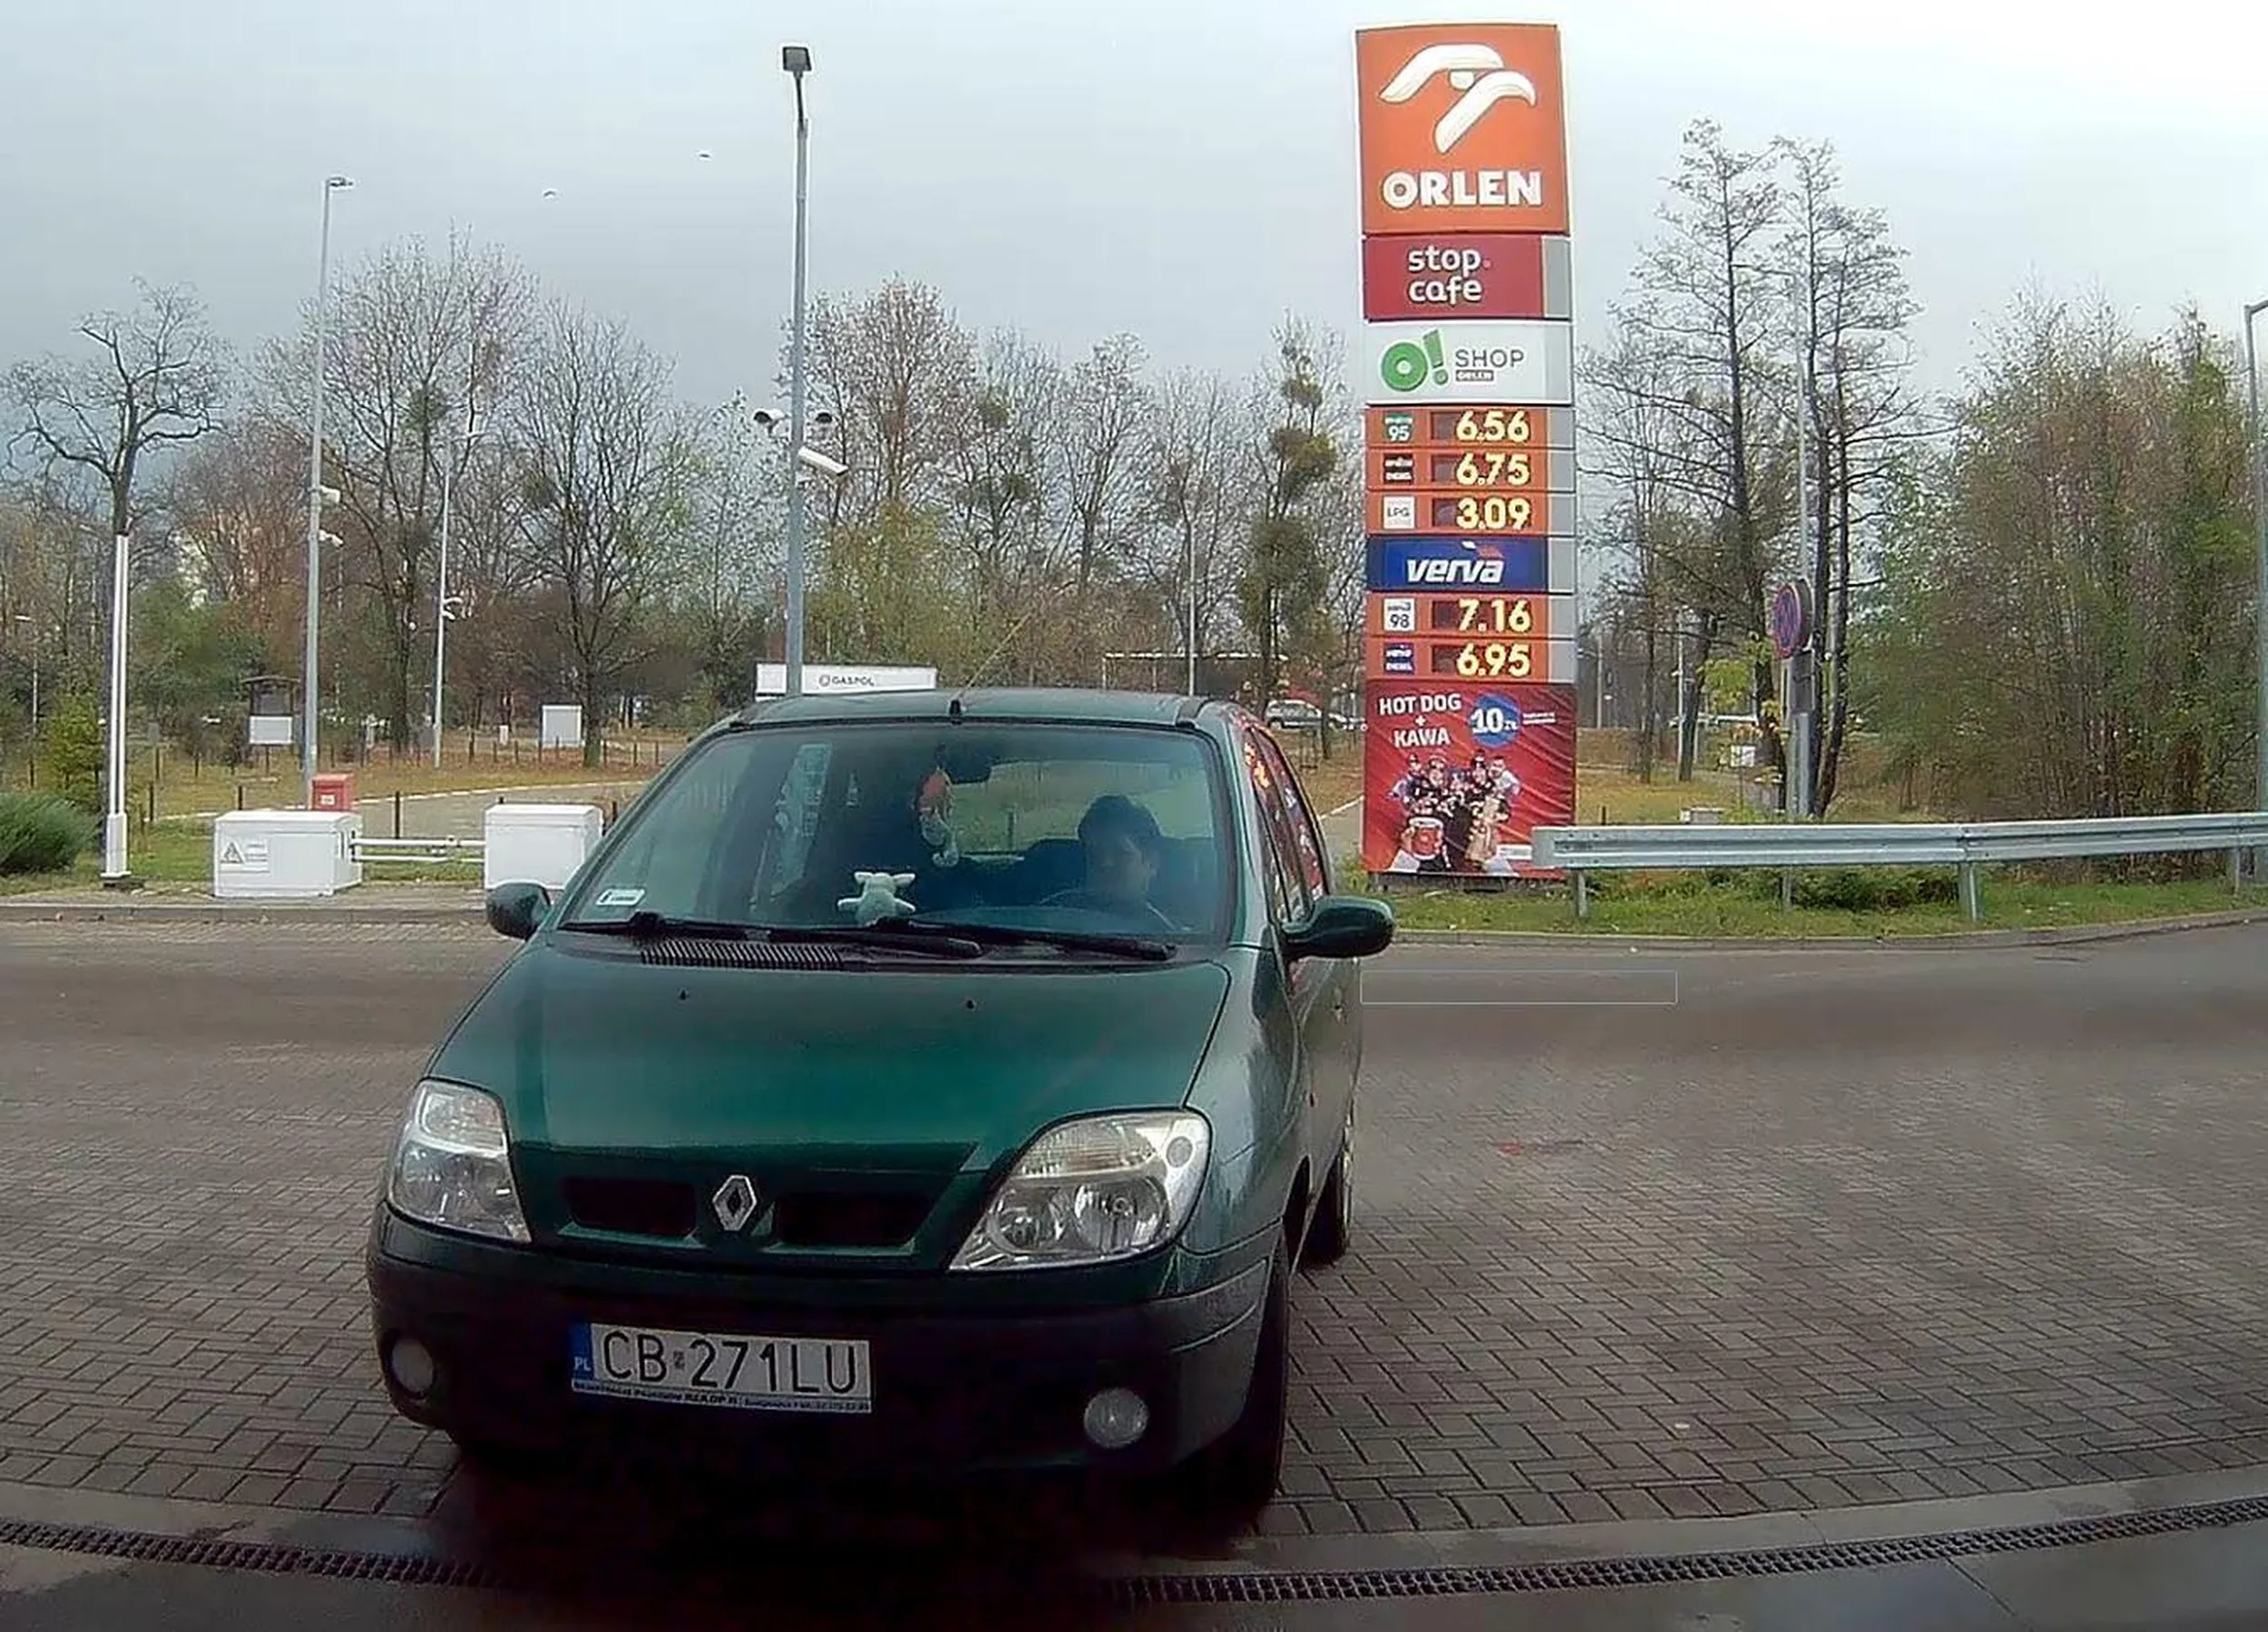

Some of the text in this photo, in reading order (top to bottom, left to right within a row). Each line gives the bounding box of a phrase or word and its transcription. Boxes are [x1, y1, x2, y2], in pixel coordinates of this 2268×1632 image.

[1382, 171, 1542, 209] ORLEN
[1408, 246, 1481, 277] stop
[1409, 277, 1482, 304] cafe
[1455, 349, 1525, 368] SHOP
[1388, 410, 1530, 443] 95 6.56
[1456, 453, 1530, 485] 6.75
[1387, 497, 1530, 530] LPG 3.09
[1407, 559, 1505, 583] verva
[1390, 599, 1531, 632] 98 7.16
[1456, 642, 1530, 676] 6.95
[832, 676, 875, 686] GASPOL
[1379, 693, 1462, 716] HOT DOG
[1393, 728, 1452, 748] KAWA
[573, 1355, 591, 1372] PL
[603, 1330, 857, 1394] CB 271LU
